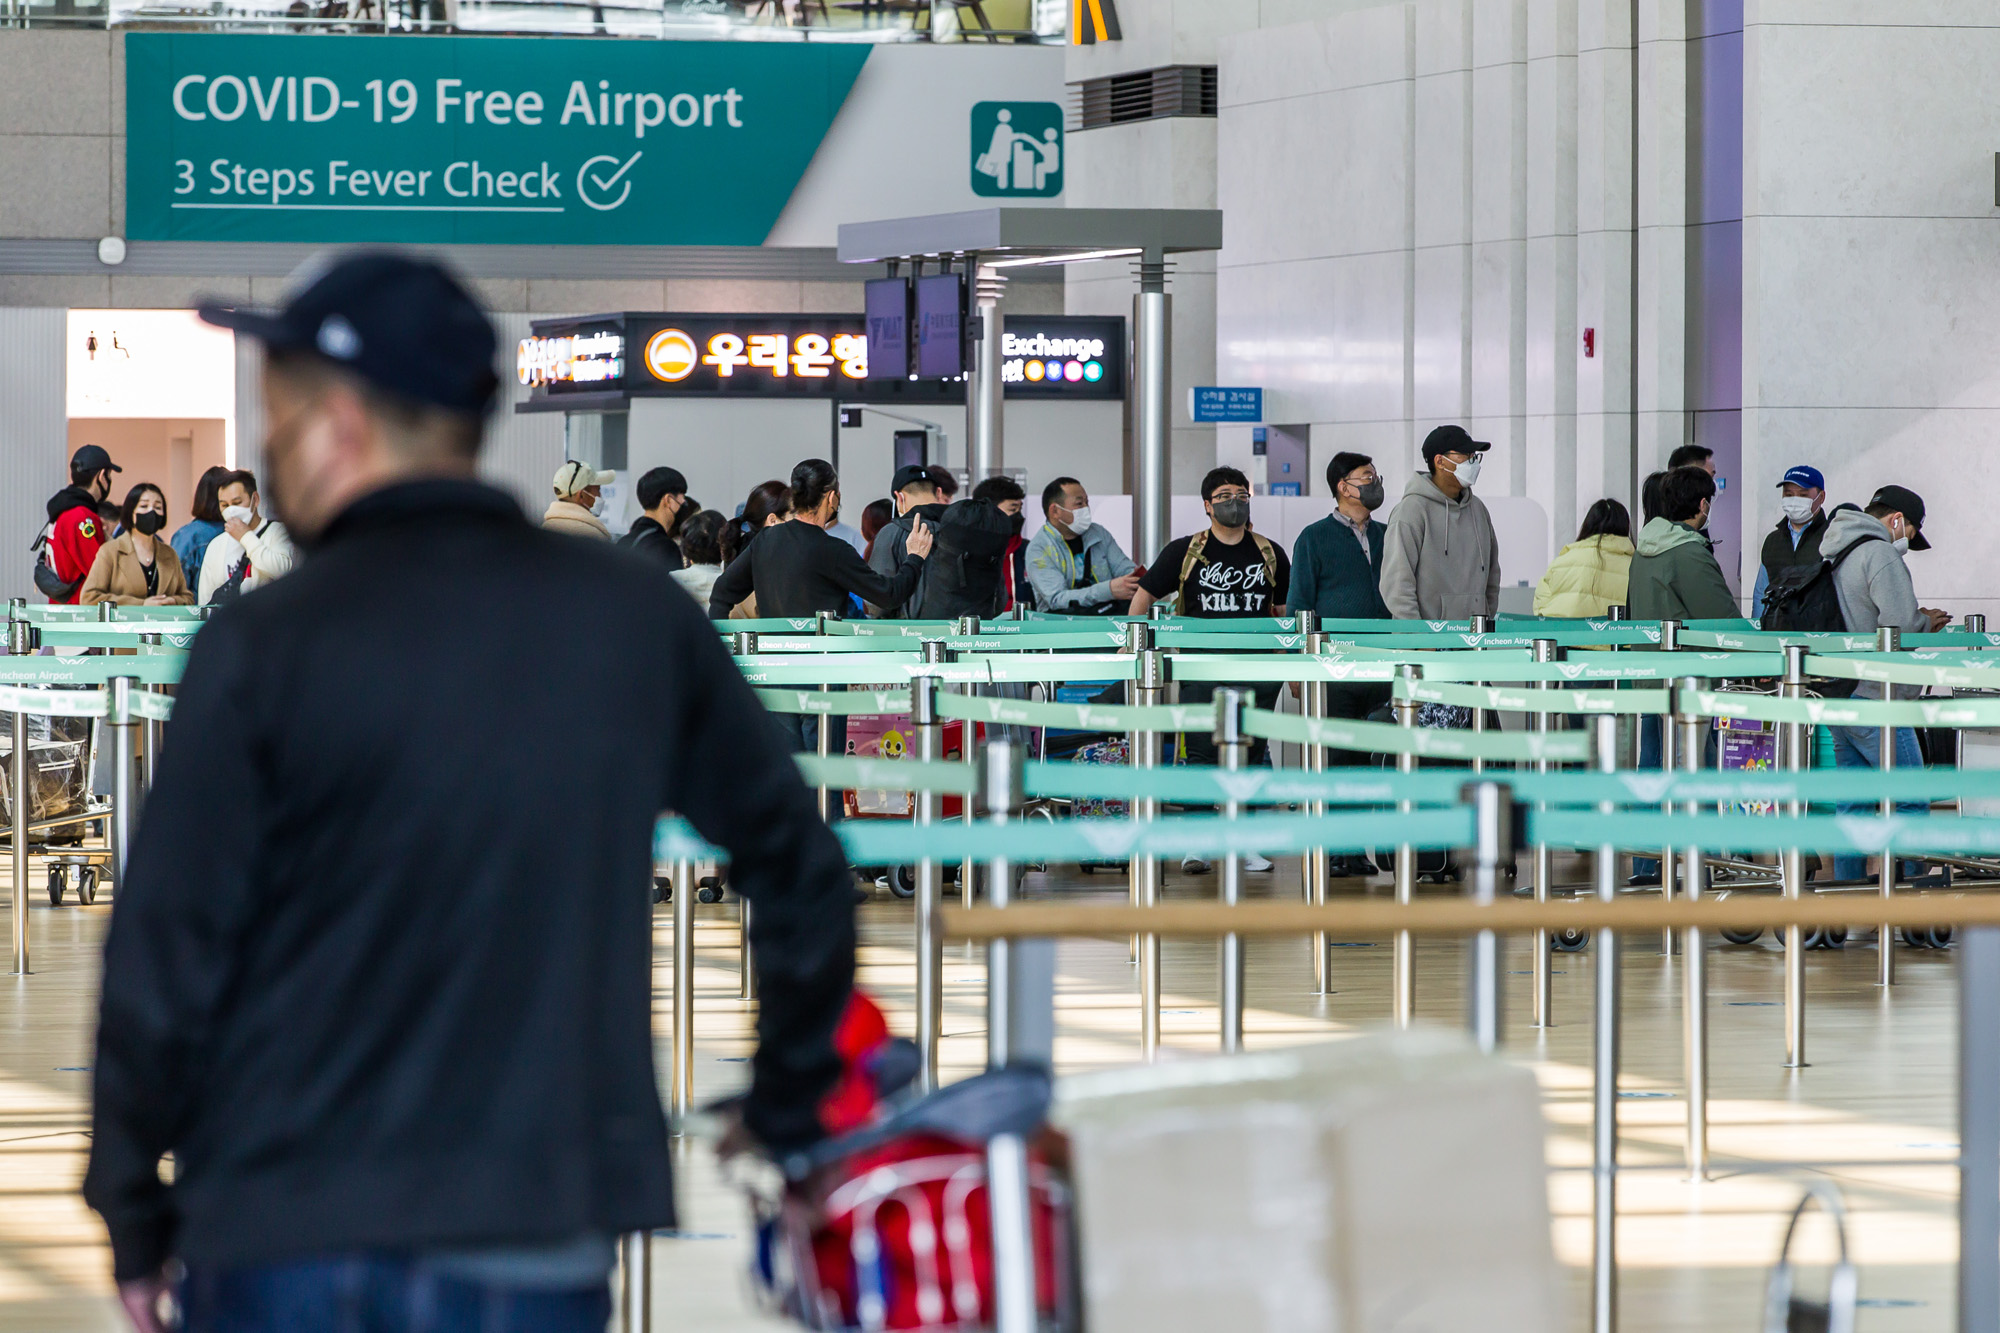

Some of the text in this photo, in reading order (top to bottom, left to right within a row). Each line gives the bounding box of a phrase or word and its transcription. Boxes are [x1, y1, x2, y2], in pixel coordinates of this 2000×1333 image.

[172, 75, 743, 138] COVID-19 Free Airport
[174, 158, 562, 205] 3 Steps Fever Check
[701, 332, 869, 379] 우리은행
[1001, 332, 1105, 362] Exchange
[1200, 592, 1266, 611] KILL IT
[785, 640, 811, 649] Airport
[38, 671, 74, 681] Airport
[1353, 669, 1389, 678] Incheon
[1586, 667, 1656, 677] Incheon Airport
